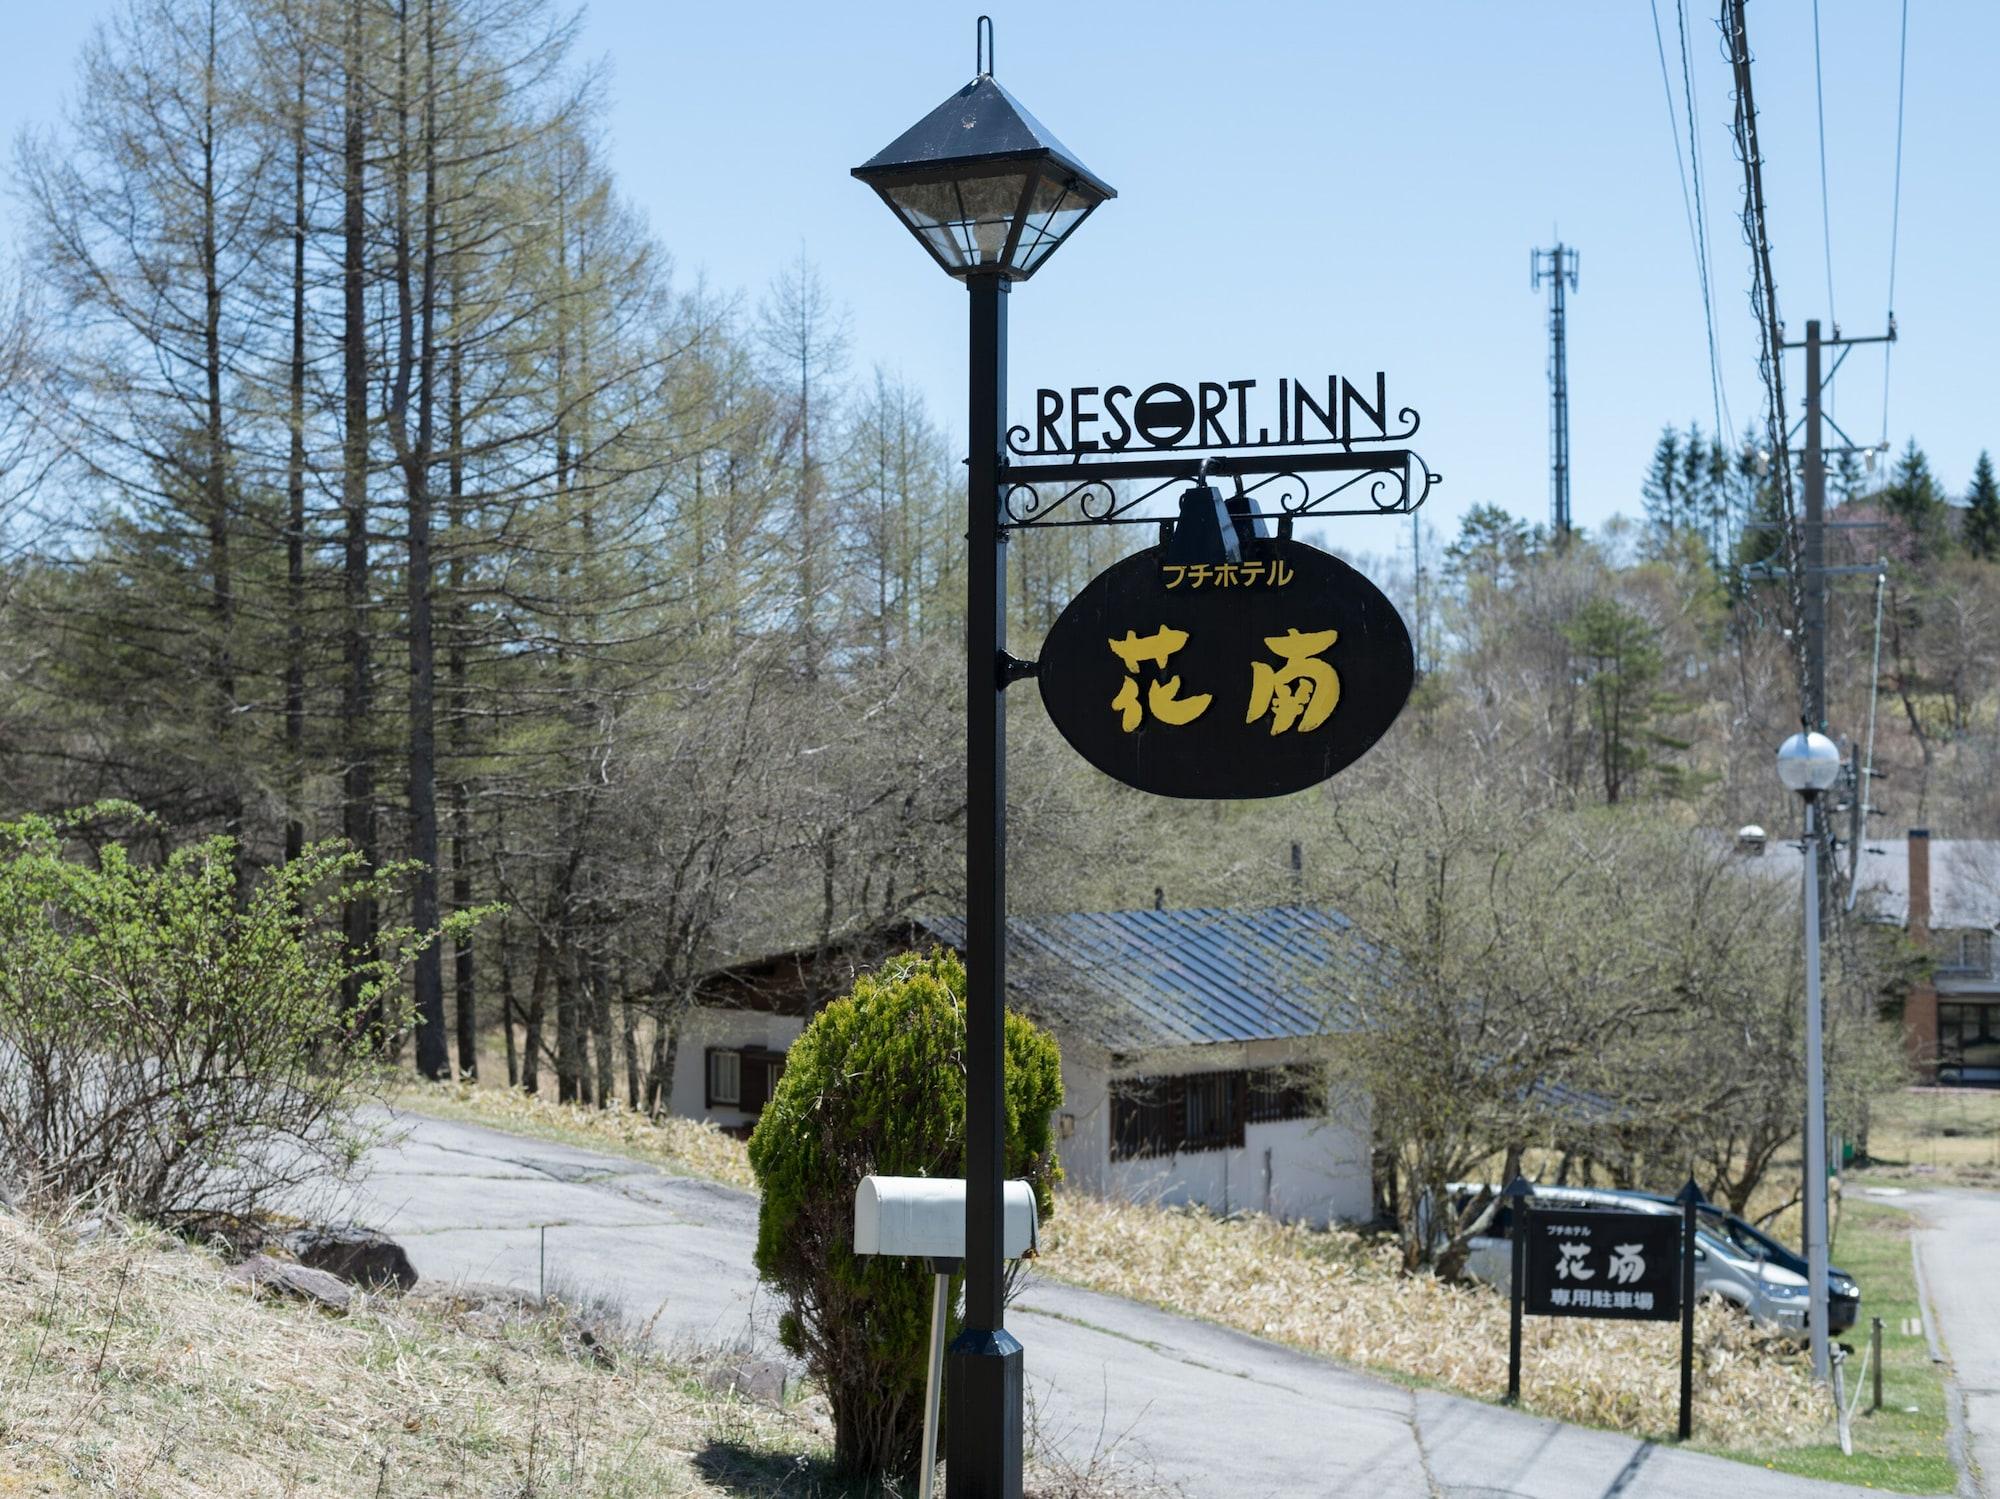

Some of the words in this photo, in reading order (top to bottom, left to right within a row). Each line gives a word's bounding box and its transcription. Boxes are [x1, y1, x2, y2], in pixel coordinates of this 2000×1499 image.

[1550, 1288, 1654, 1310] 専用駐車場
